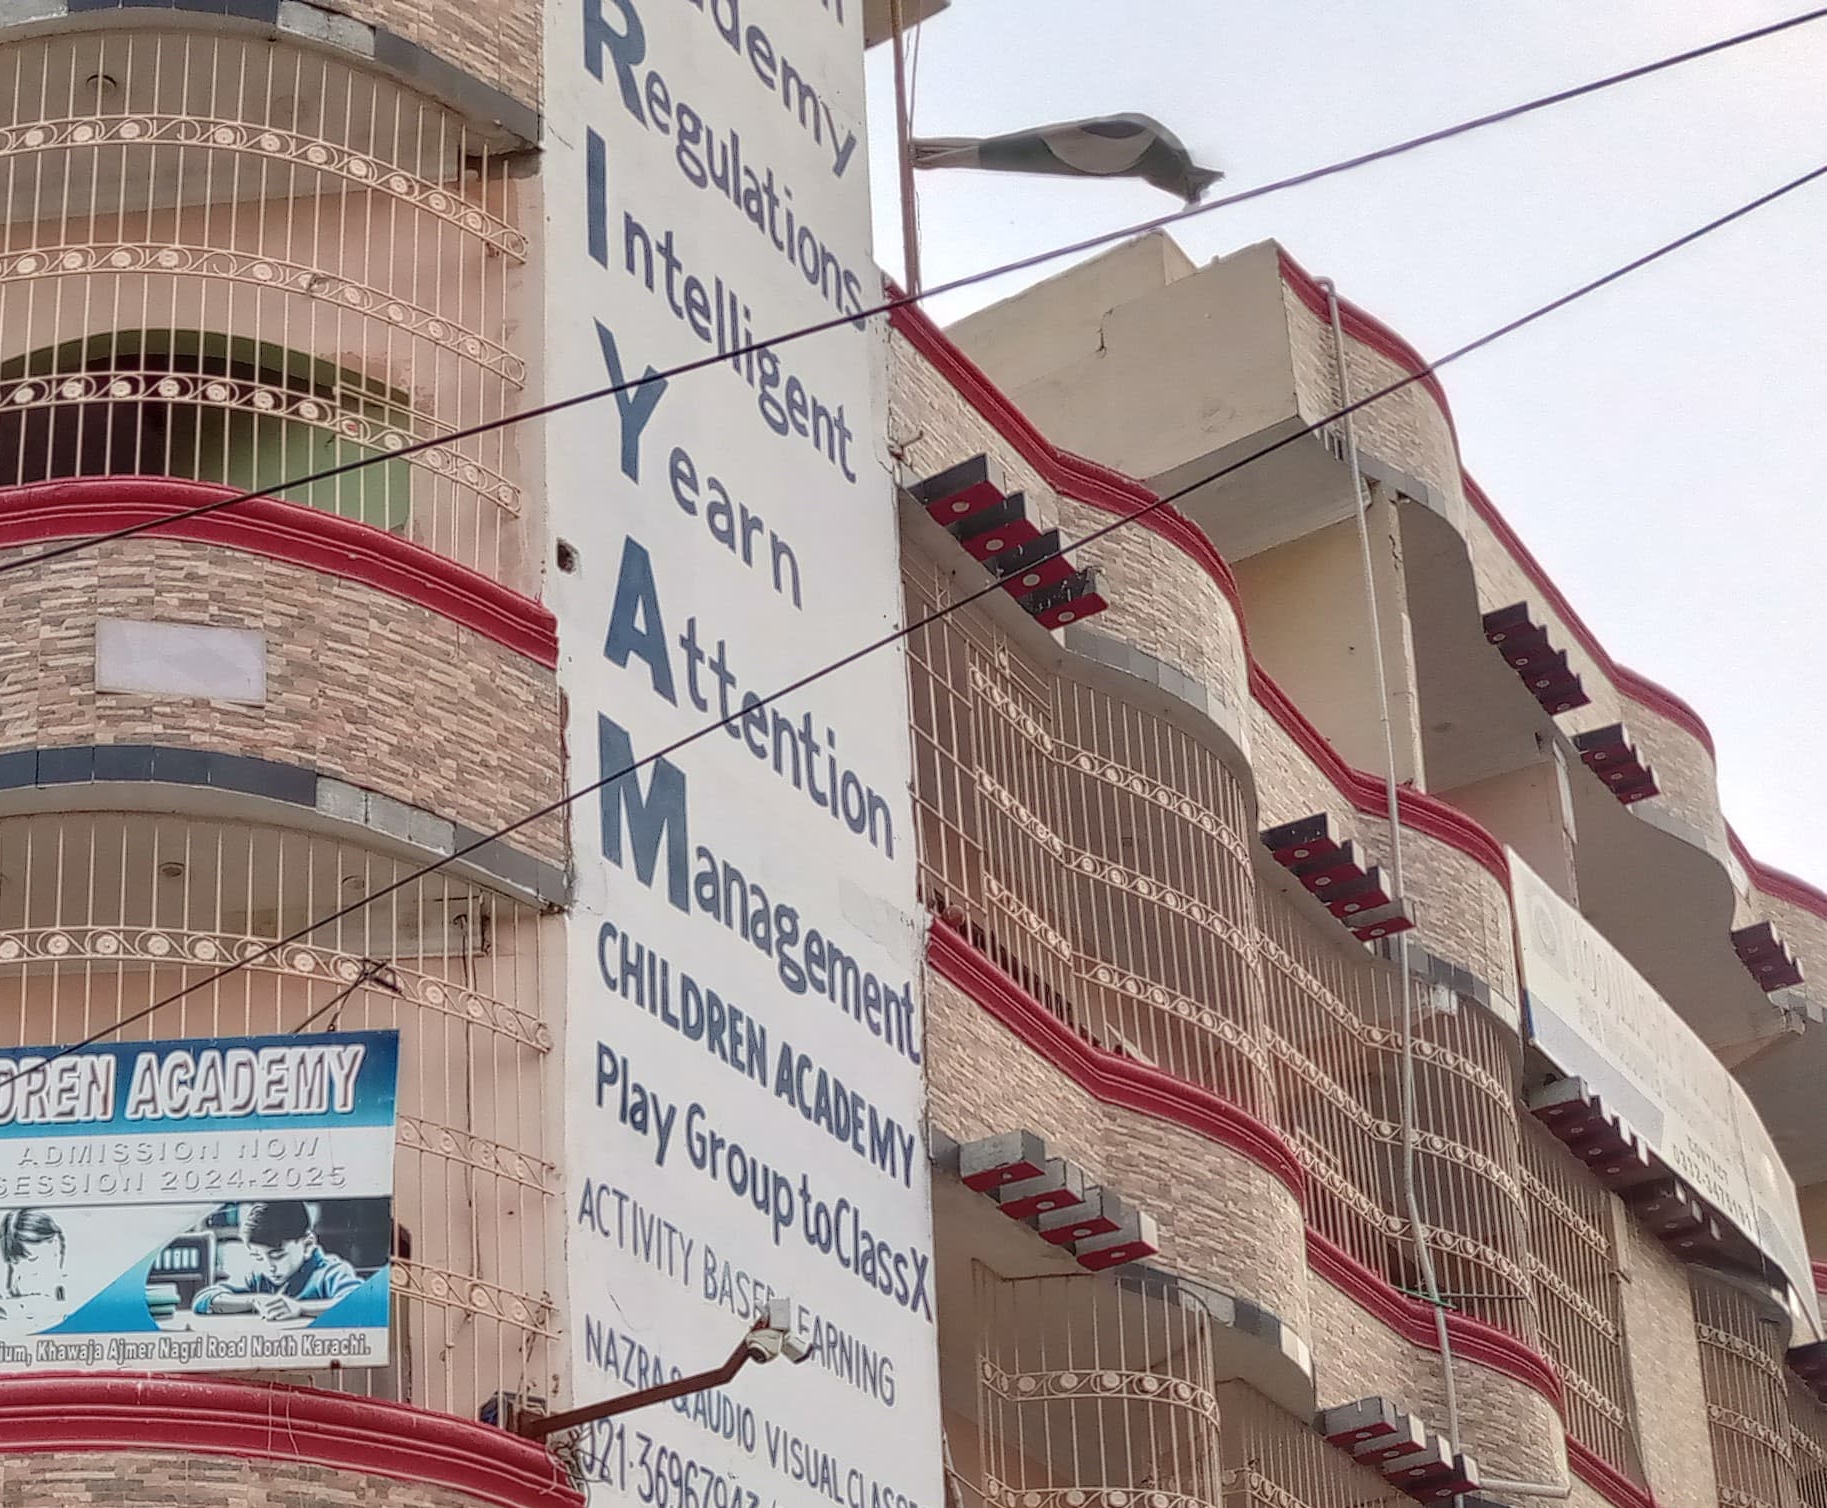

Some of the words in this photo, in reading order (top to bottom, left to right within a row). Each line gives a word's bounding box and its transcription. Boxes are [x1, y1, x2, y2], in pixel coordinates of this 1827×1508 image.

[583, 0, 866, 331] Regulations
[586, 125, 856, 483] Intelligent
[593, 317, 802, 611] Yearn
[603, 534, 893, 860] Attention
[597, 711, 920, 1064] Management
[16, 1139, 220, 1168] ADMISSION
[237, 1134, 321, 1160] NOW
[125, 1043, 365, 1119] ACADEMY
[596, 1040, 677, 1166] Play
[686, 1102, 794, 1245] Group
[597, 922, 768, 1087] CHILDREN
[775, 1041, 915, 1188] ACADEMY
[160, 1165, 348, 1193] 2024-2025
[577, 1178, 693, 1286] ACTIVITY
[798, 1304, 895, 1406] EARNING
[36, 1337, 104, 1366] Khawaja
[106, 1337, 155, 1364] Ajmer
[157, 1335, 203, 1363] Nagri
[206, 1335, 247, 1359] Road
[251, 1333, 298, 1359] North
[301, 1332, 372, 1358] Karachi.
[766, 1420, 844, 1505] VISUAL
